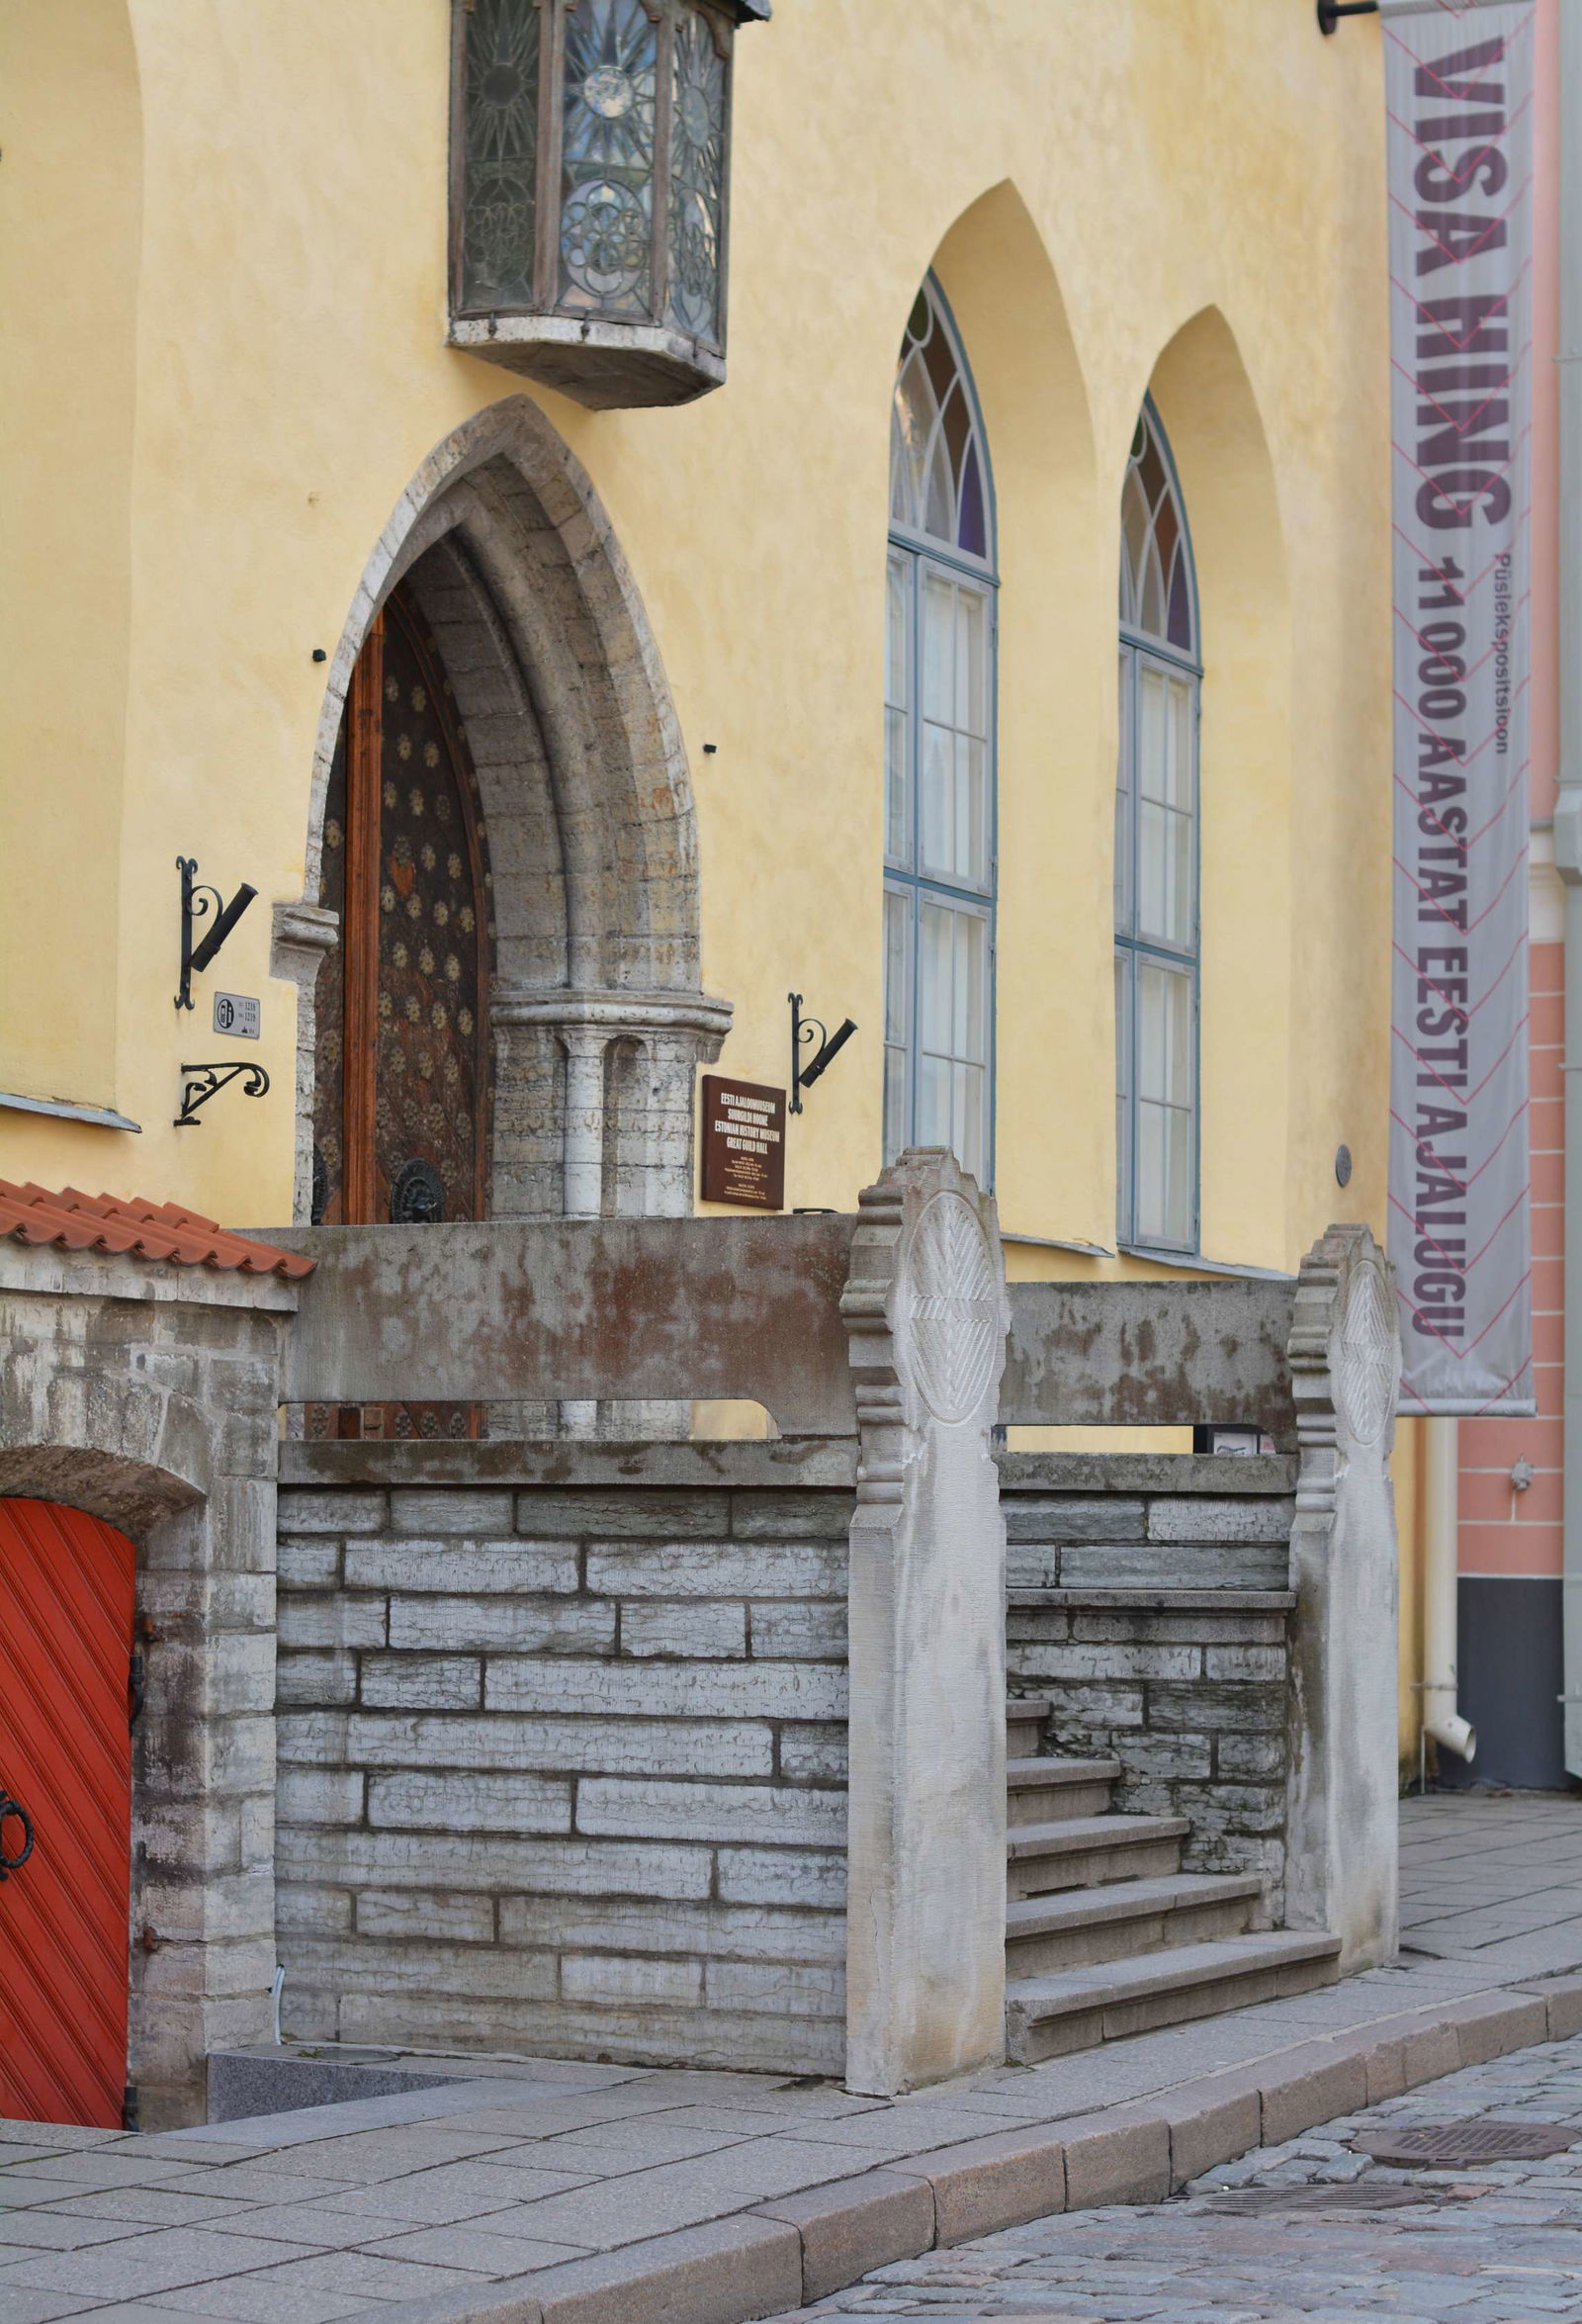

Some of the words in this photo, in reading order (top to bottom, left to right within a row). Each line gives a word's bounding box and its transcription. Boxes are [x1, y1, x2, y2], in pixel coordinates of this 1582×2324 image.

[1414, 37, 1507, 276] VISA
[1415, 295, 1512, 530] HING
[1494, 553, 1512, 755] Püsiekspositsioon
[1418, 733, 1468, 930] AASTAT
[1416, 946, 1469, 1087] EESTI
[1412, 1103, 1468, 1337] AJALUGU
